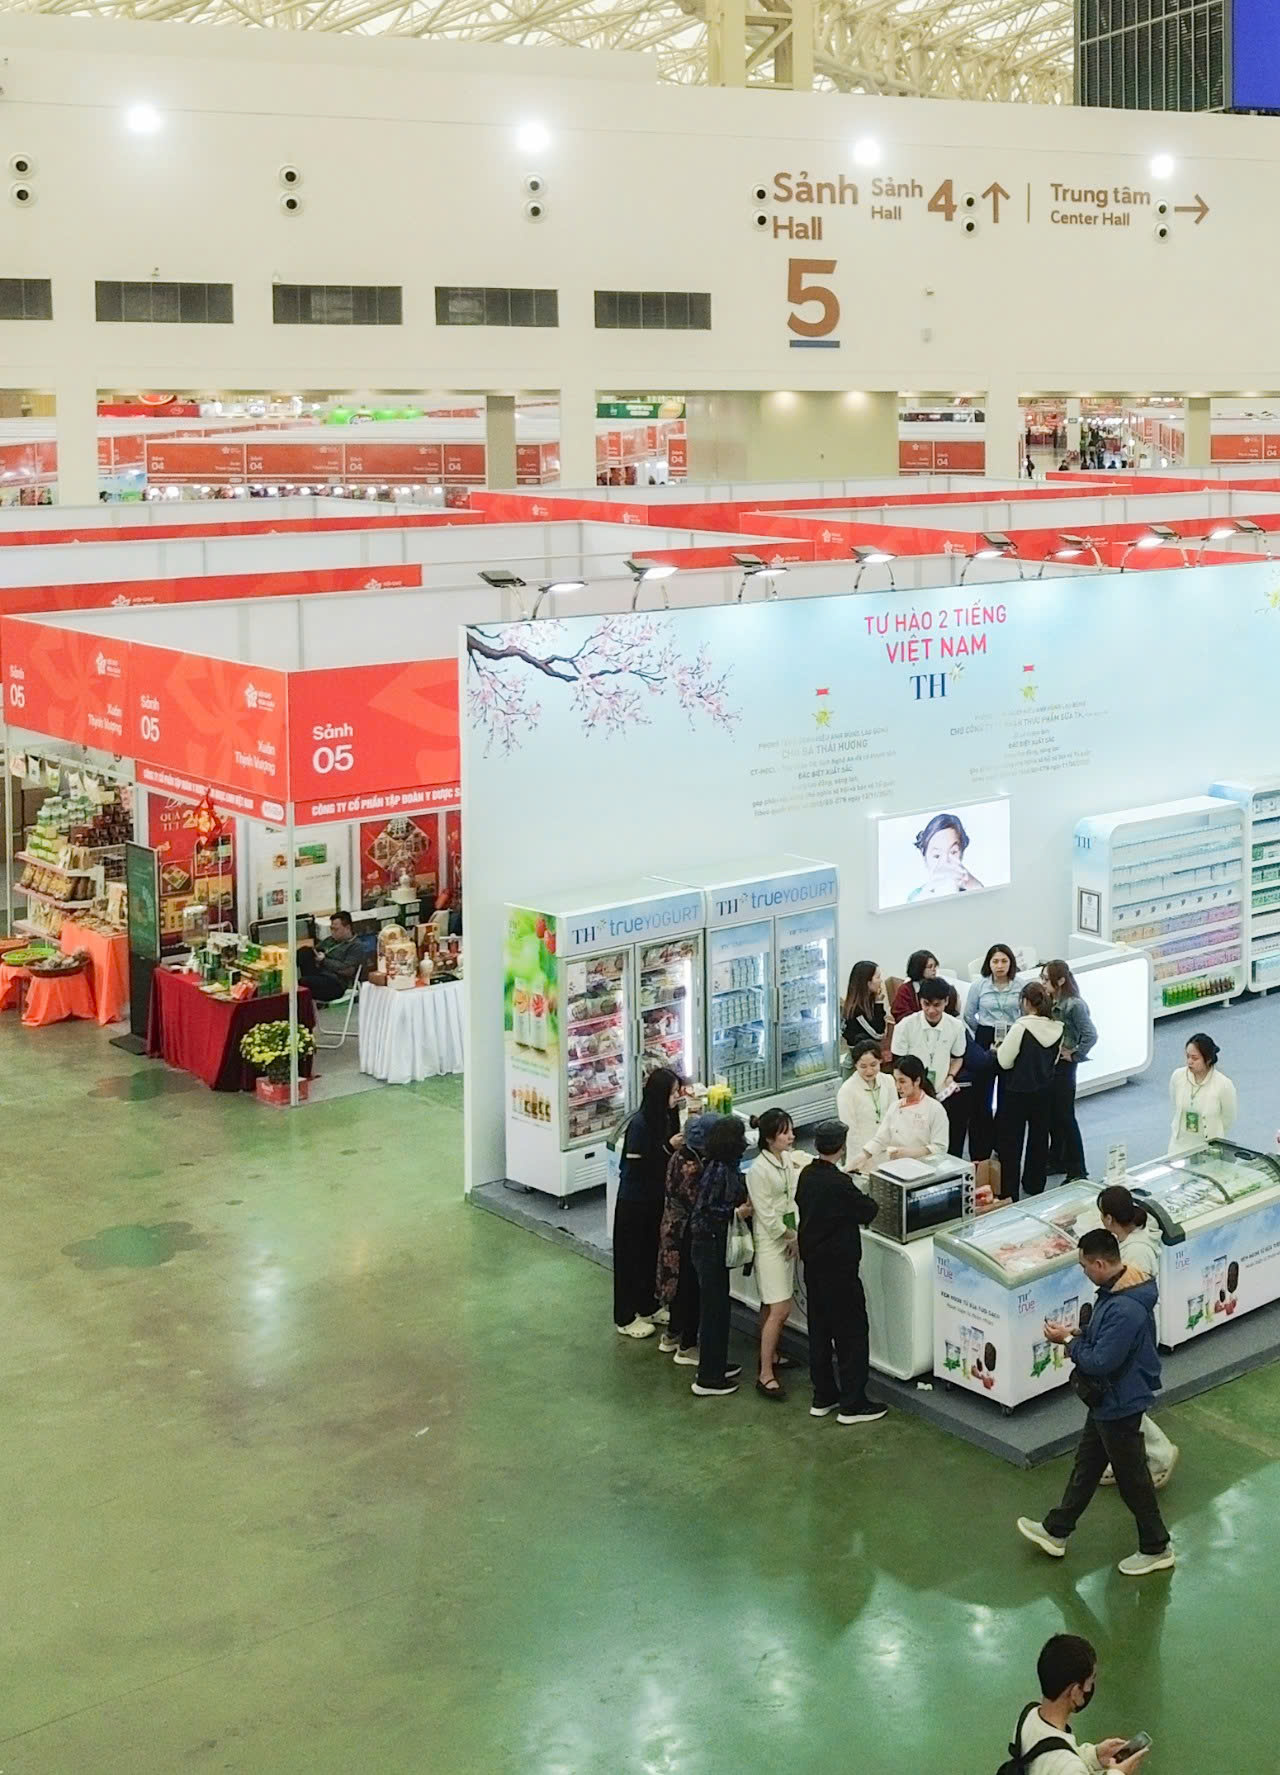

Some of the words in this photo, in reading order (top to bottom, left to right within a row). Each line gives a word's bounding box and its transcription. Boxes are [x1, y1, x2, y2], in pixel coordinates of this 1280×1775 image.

[773, 171, 858, 205] Sảnh
[871, 176, 923, 199] Sảnh
[1050, 183, 1108, 207] Trung
[1111, 187, 1151, 206] tâm
[927, 179, 957, 221] 4
[871, 205, 902, 220] Hall
[1050, 211, 1097, 226] Center
[1101, 212, 1130, 227] Hall
[773, 215, 823, 241] Hall
[787, 258, 840, 337] 5
[151, 462, 164, 470] 04
[249, 462, 263, 470] 04
[671, 456, 683, 464] 04
[864, 611, 889, 639] TỰ
[895, 605, 933, 633] HÀO
[939, 610, 948, 628] 2
[955, 599, 1007, 627] TIẾNG
[886, 634, 933, 666] VIỆT
[941, 633, 987, 660] NAM
[10, 683, 25, 708] 05
[909, 672, 947, 701] TH
[141, 715, 160, 742] 05
[312, 723, 353, 741] Sảnh
[838, 739, 868, 751] HƯƠNG
[312, 744, 354, 774] 05
[311, 802, 335, 817] CÔNG
[336, 803, 347, 814] TY
[348, 796, 361, 812] CỔ
[361, 795, 384, 810] PHẦN
[716, 899, 740, 917] TH
[572, 924, 596, 945] TH
